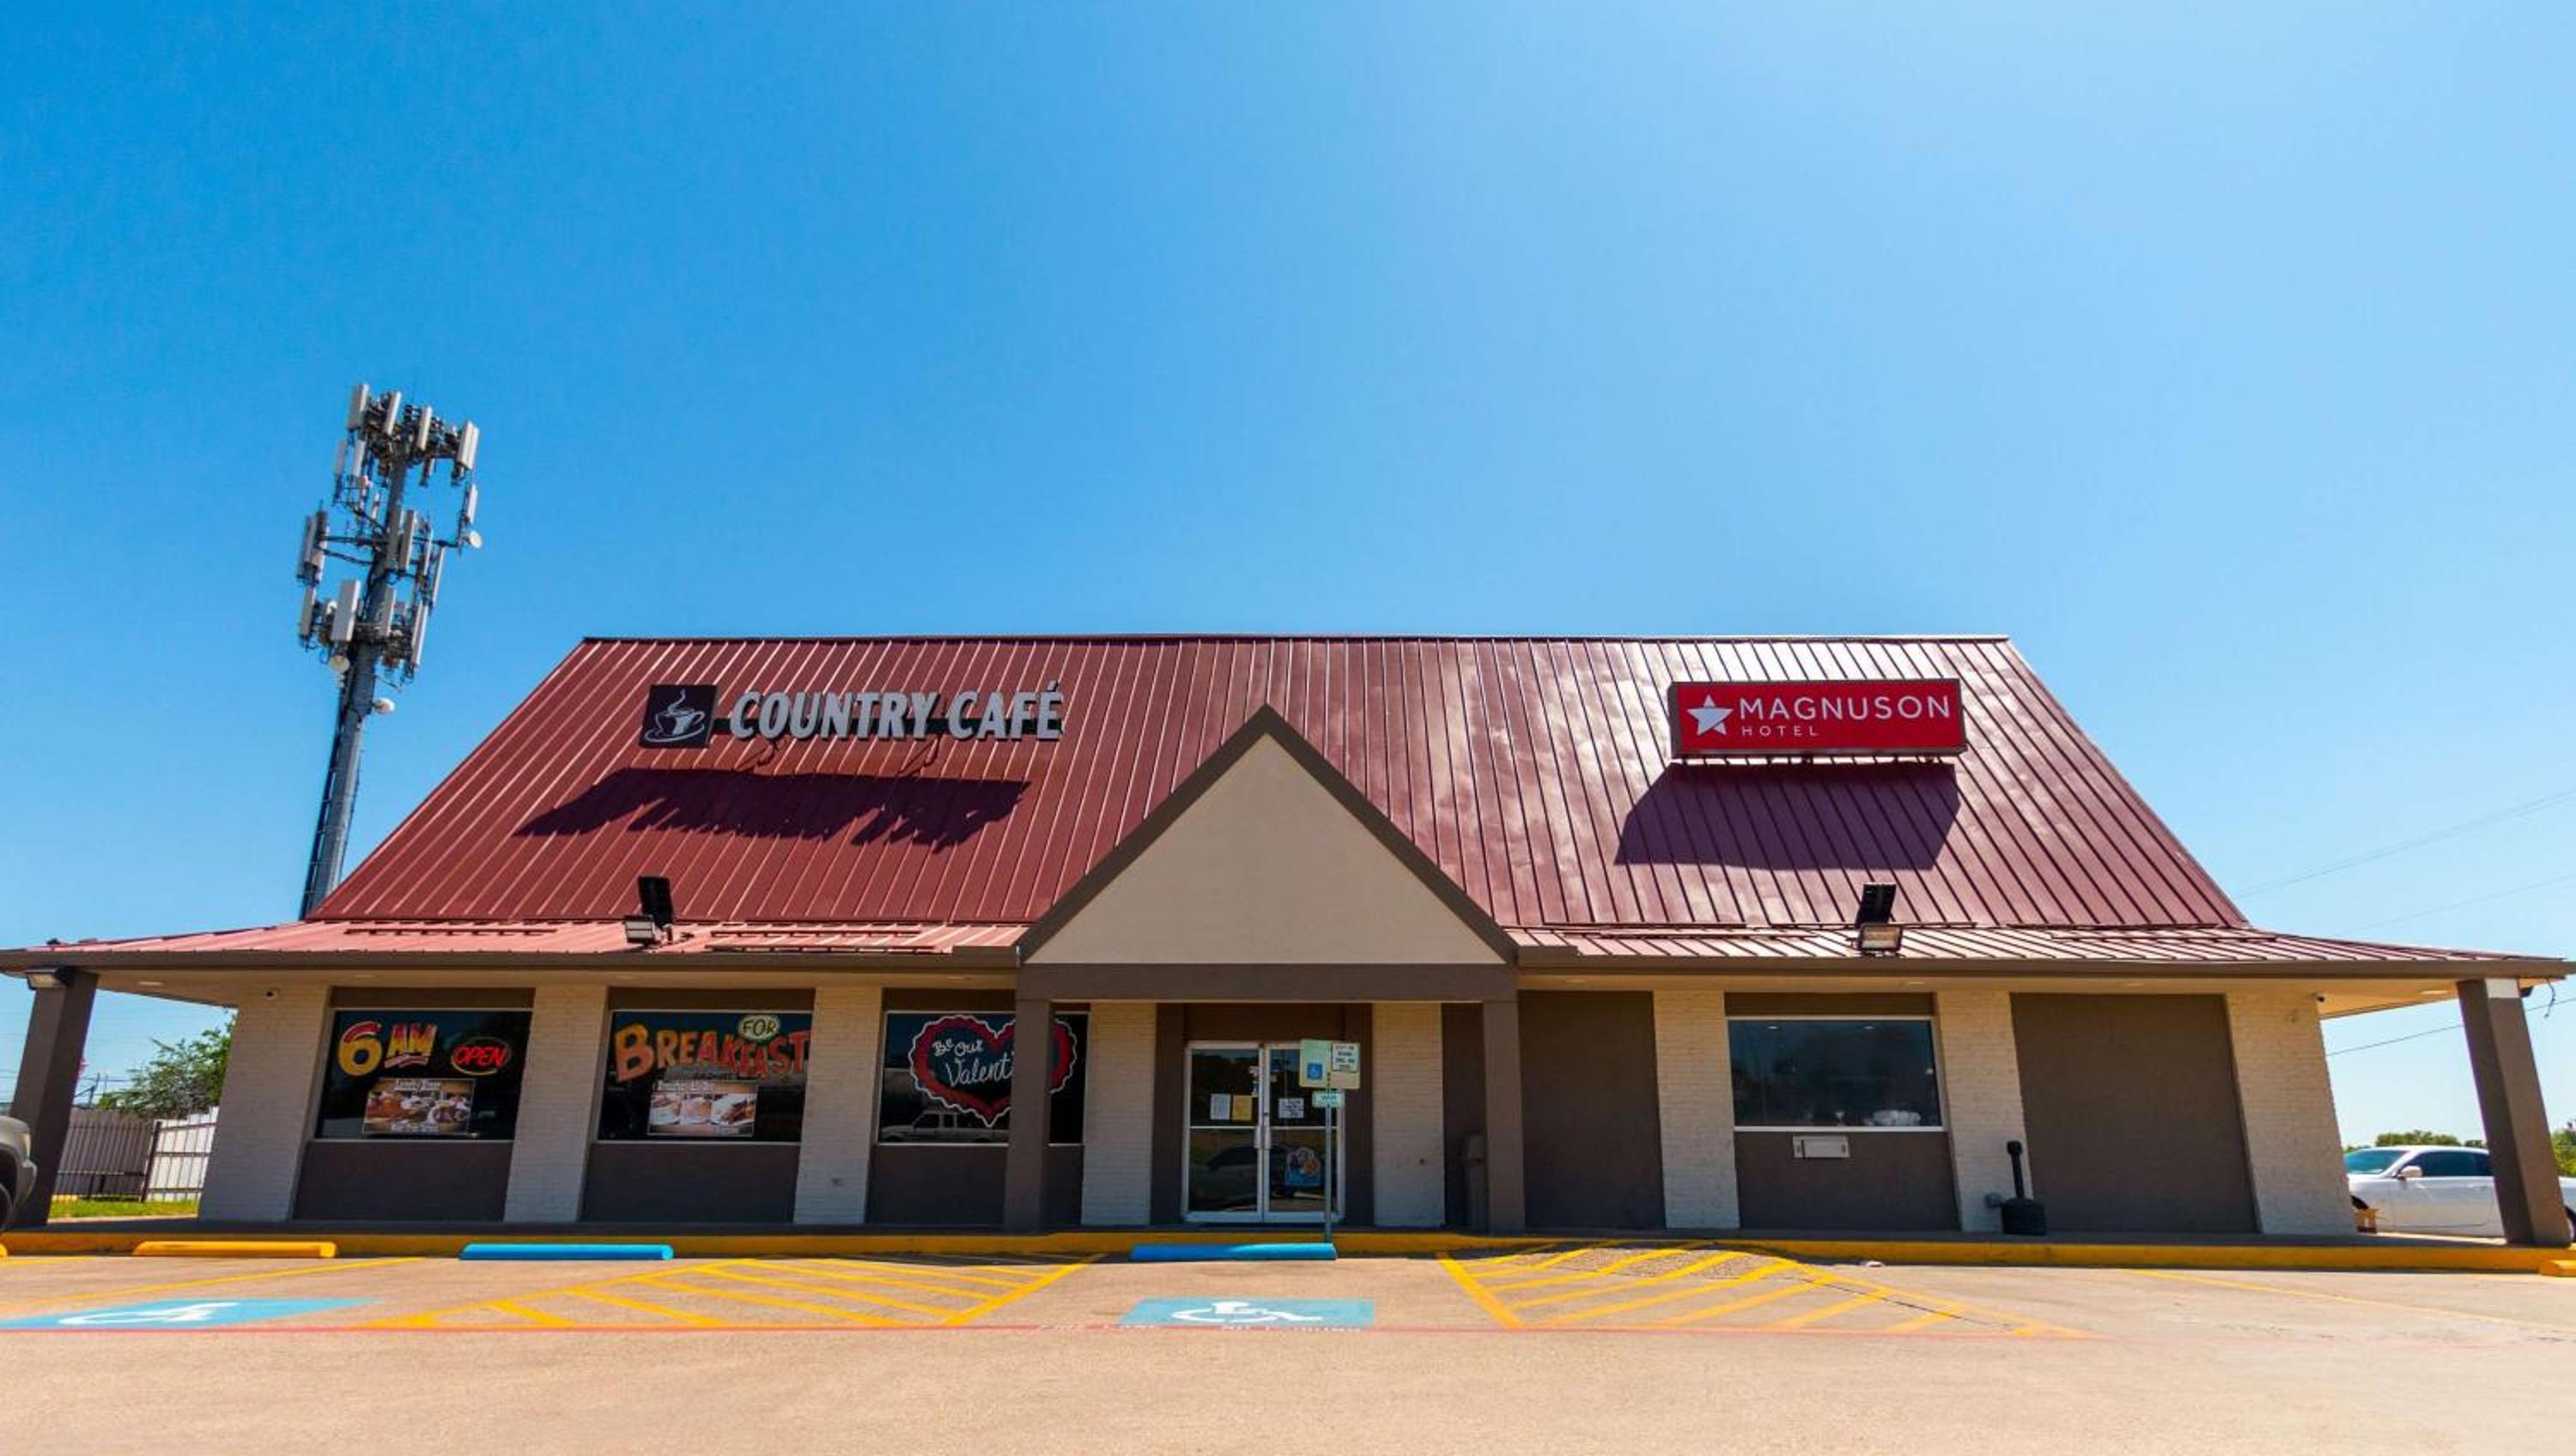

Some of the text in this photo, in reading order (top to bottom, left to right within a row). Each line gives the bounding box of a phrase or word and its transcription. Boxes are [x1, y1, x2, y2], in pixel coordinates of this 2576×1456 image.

[729, 680, 1065, 741] COUNTRY CAFÉ
[1740, 695, 1950, 720] MAGNUSON
[1741, 725, 1820, 737] HOTEL
[742, 1019, 777, 1036] FOR
[337, 1020, 438, 1076] 6 AM
[453, 1045, 508, 1069] OPEN
[614, 1022, 811, 1083] BREAKFAST
[945, 1050, 1016, 1088] Valenti
